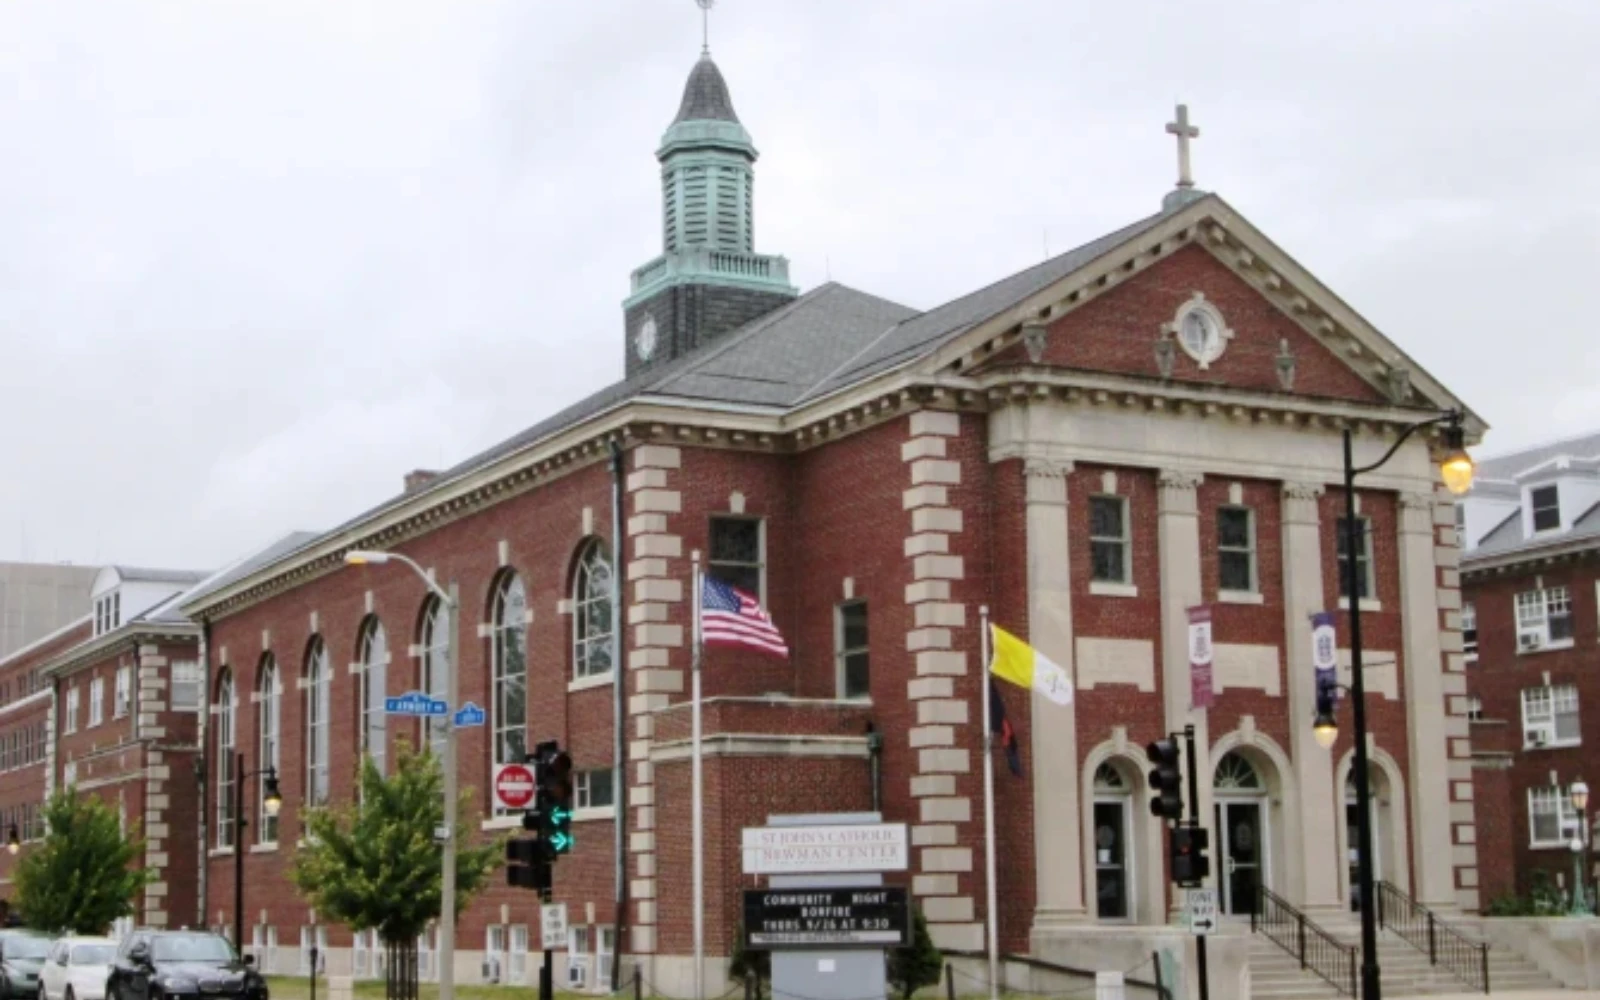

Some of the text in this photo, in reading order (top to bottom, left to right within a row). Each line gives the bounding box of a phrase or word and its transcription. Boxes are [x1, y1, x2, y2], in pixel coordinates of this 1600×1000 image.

[762, 832, 776, 843] ST
[763, 847, 832, 860] NEWMAN
[763, 891, 888, 906] COMMUNITY NIGHT
[801, 906, 851, 918] BONFIRE
[840, 918, 856, 930] AT
